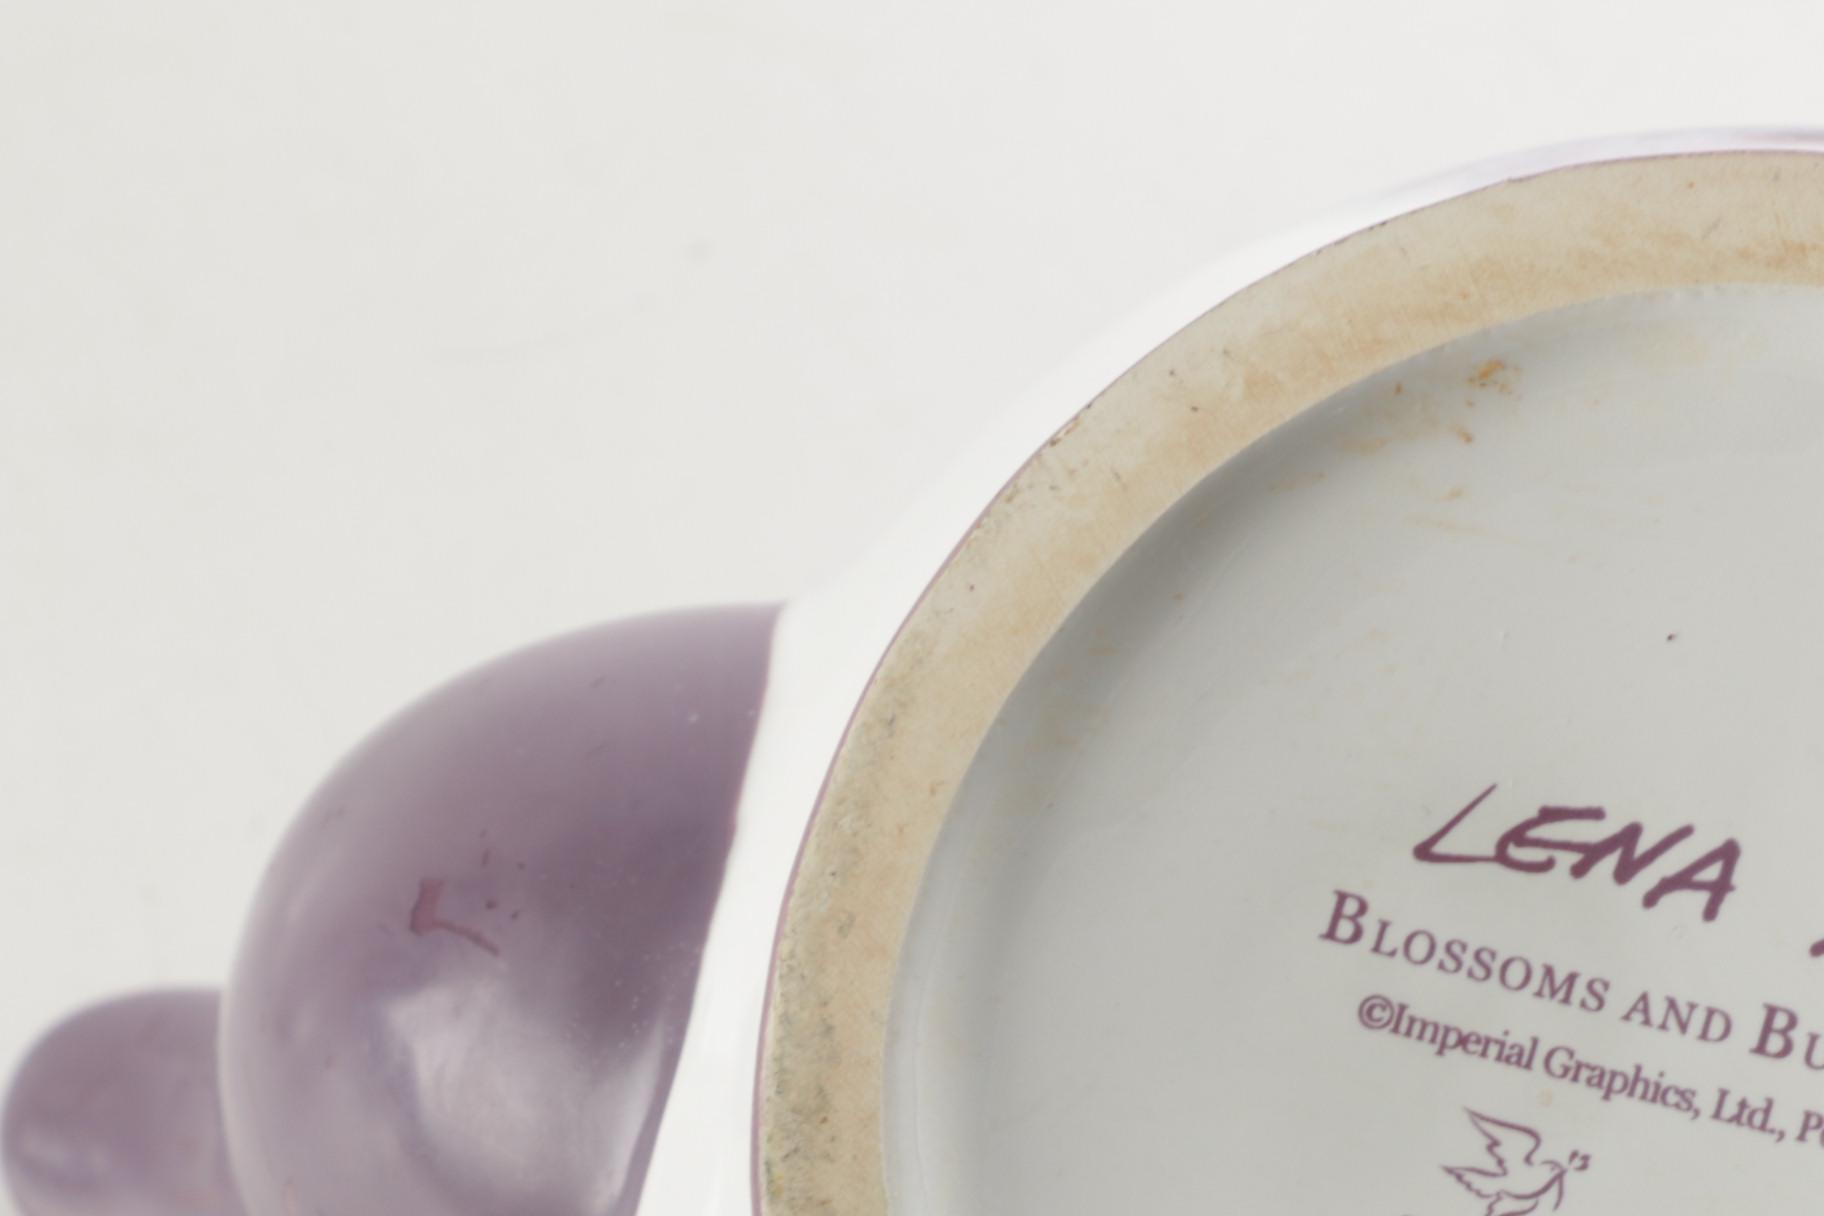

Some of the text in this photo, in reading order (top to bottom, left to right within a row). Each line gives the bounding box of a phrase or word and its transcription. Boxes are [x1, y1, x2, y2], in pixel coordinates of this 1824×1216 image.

[1412, 784, 1742, 923] LENA
[1320, 889, 1611, 1013] BLOSSOMS
[1620, 991, 1733, 1042] AND
[1542, 1045, 1702, 1119] Graphics,
[1710, 1087, 1787, 1143] Ltd.,
